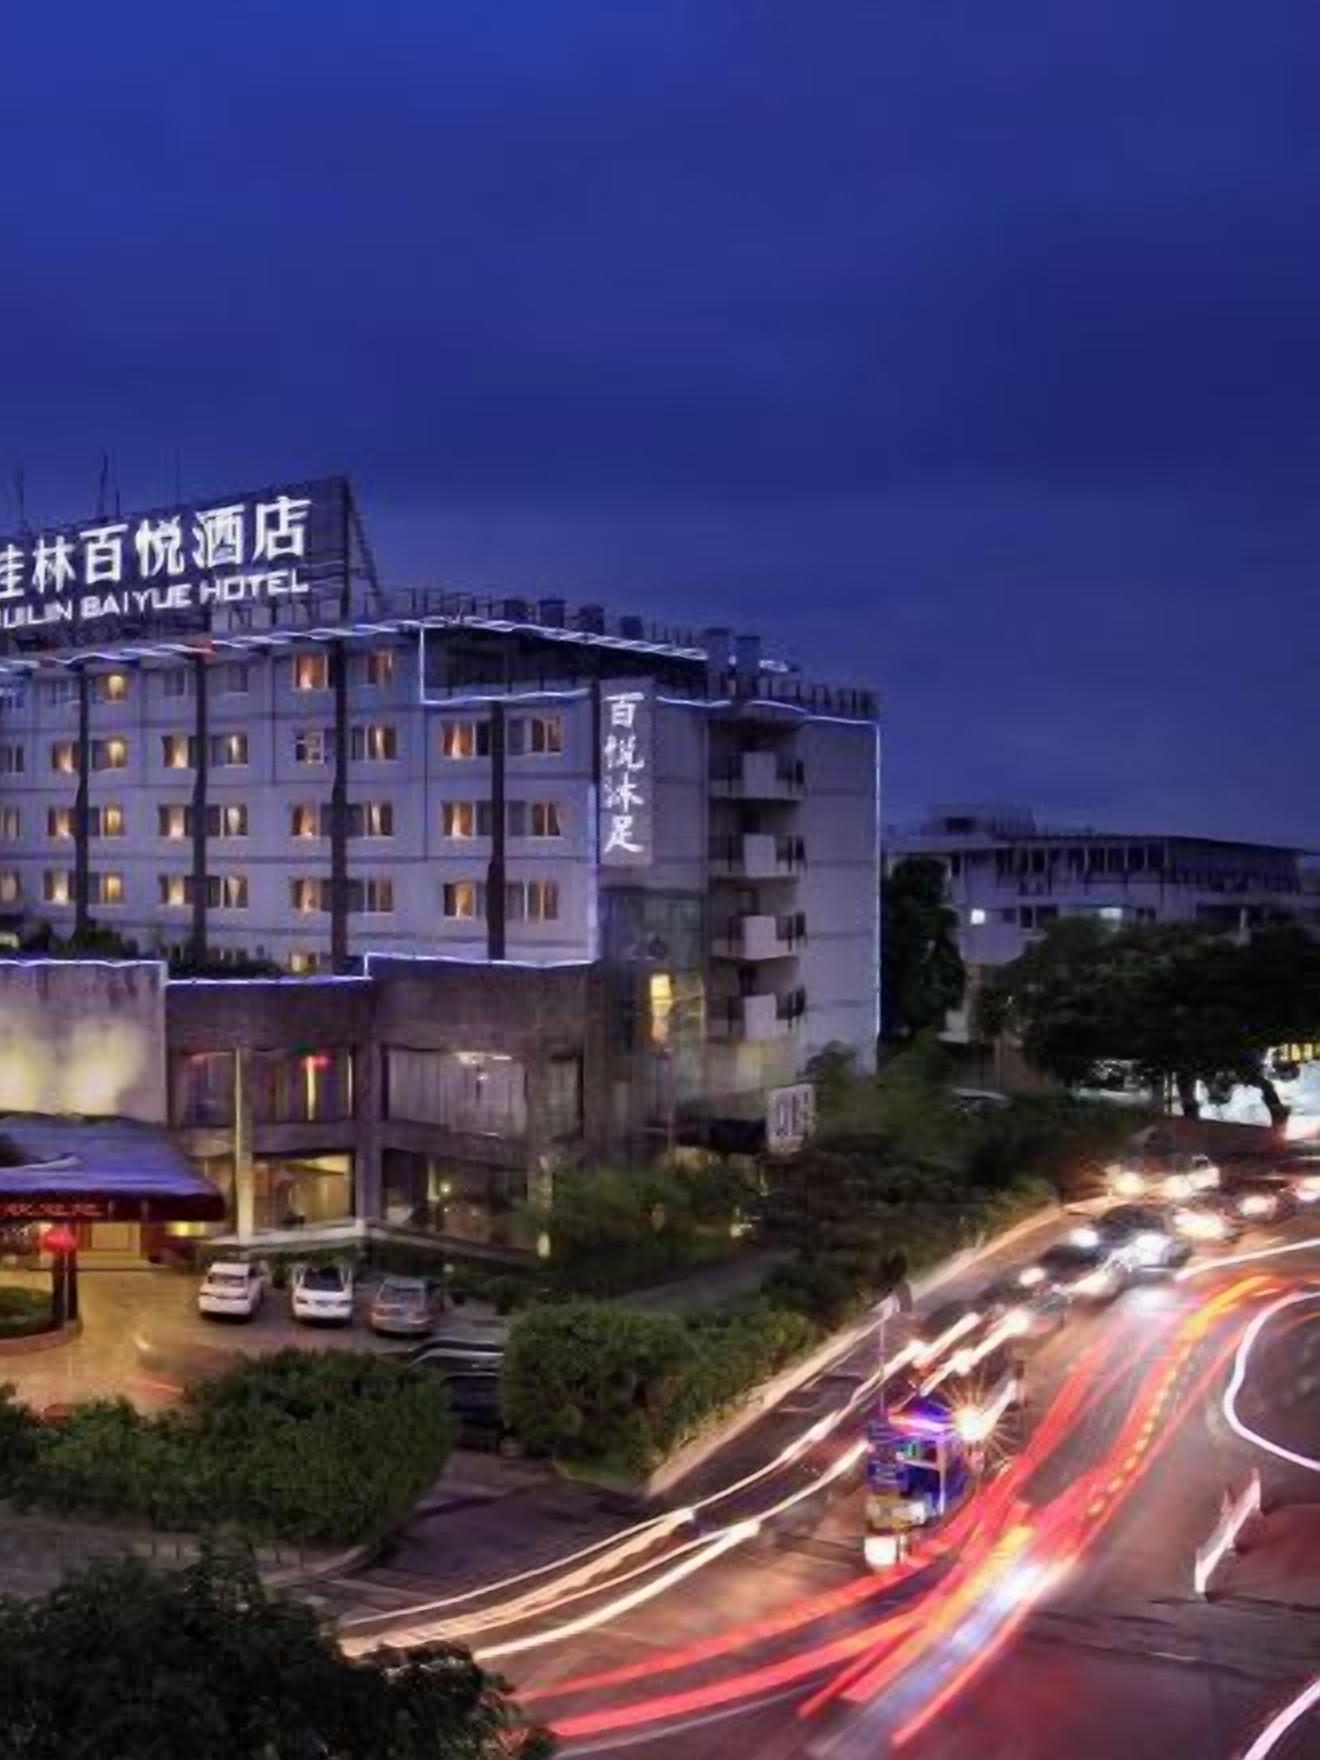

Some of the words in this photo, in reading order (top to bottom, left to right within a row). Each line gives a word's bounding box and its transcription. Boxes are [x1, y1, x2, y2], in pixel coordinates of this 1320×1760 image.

[199, 568, 310, 604] HOTEL
[603, 691, 645, 853] 百悦沐足
